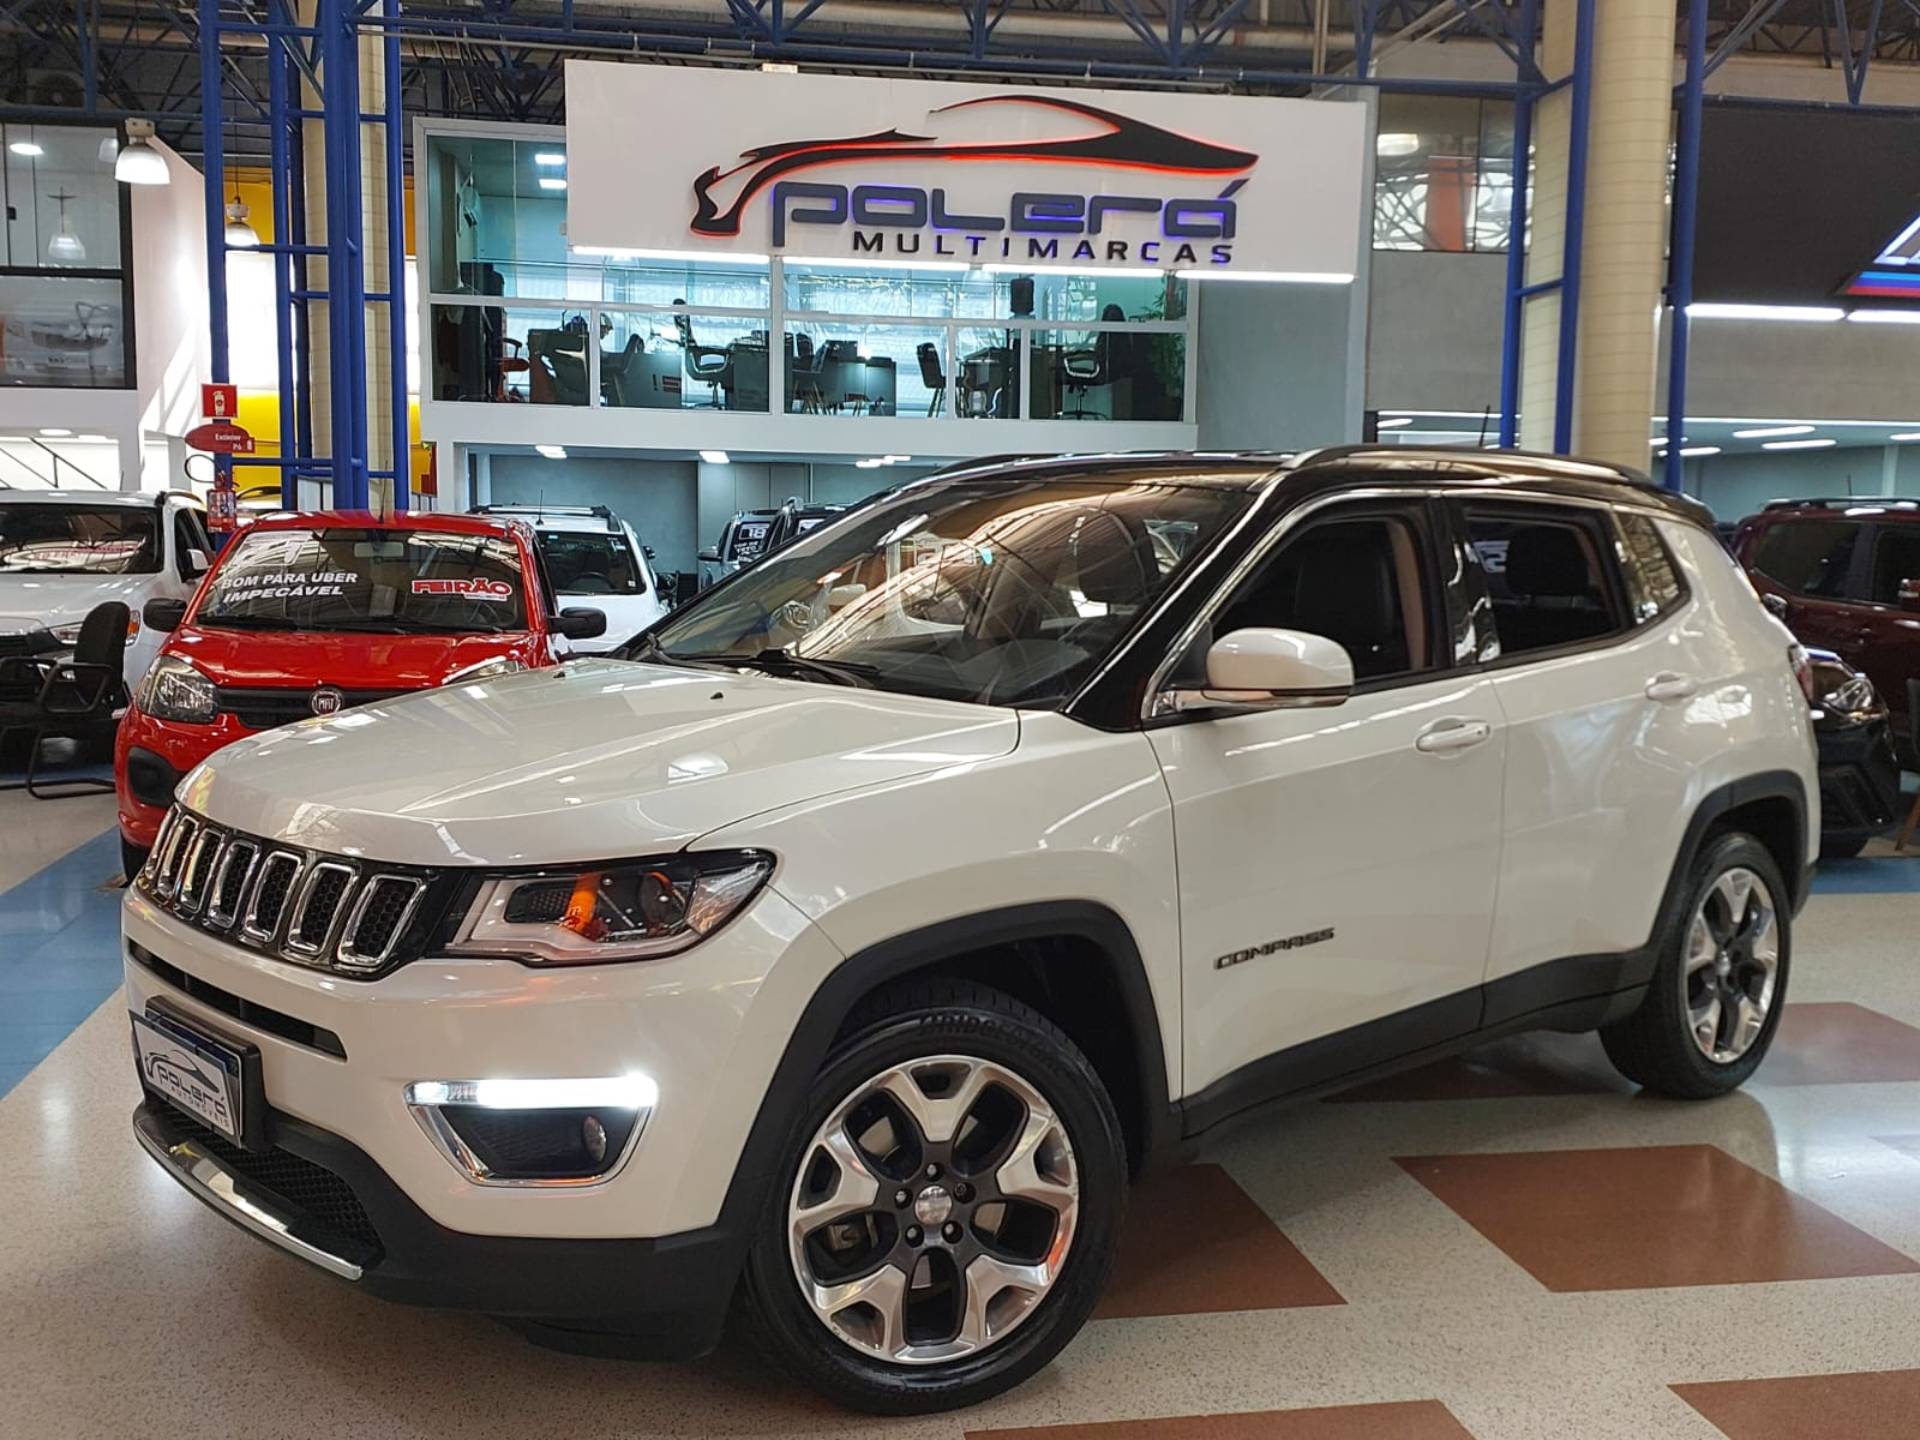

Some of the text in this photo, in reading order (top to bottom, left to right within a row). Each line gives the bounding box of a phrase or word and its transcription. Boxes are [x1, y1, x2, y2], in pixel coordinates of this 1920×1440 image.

[853, 230, 1233, 264] MULTIMARCAS
[221, 572, 358, 589] BOM PARA UBER
[411, 577, 512, 596] FEIRÃO
[223, 585, 343, 603] IMPECÁVEL
[1213, 926, 1335, 970] COMPASS
